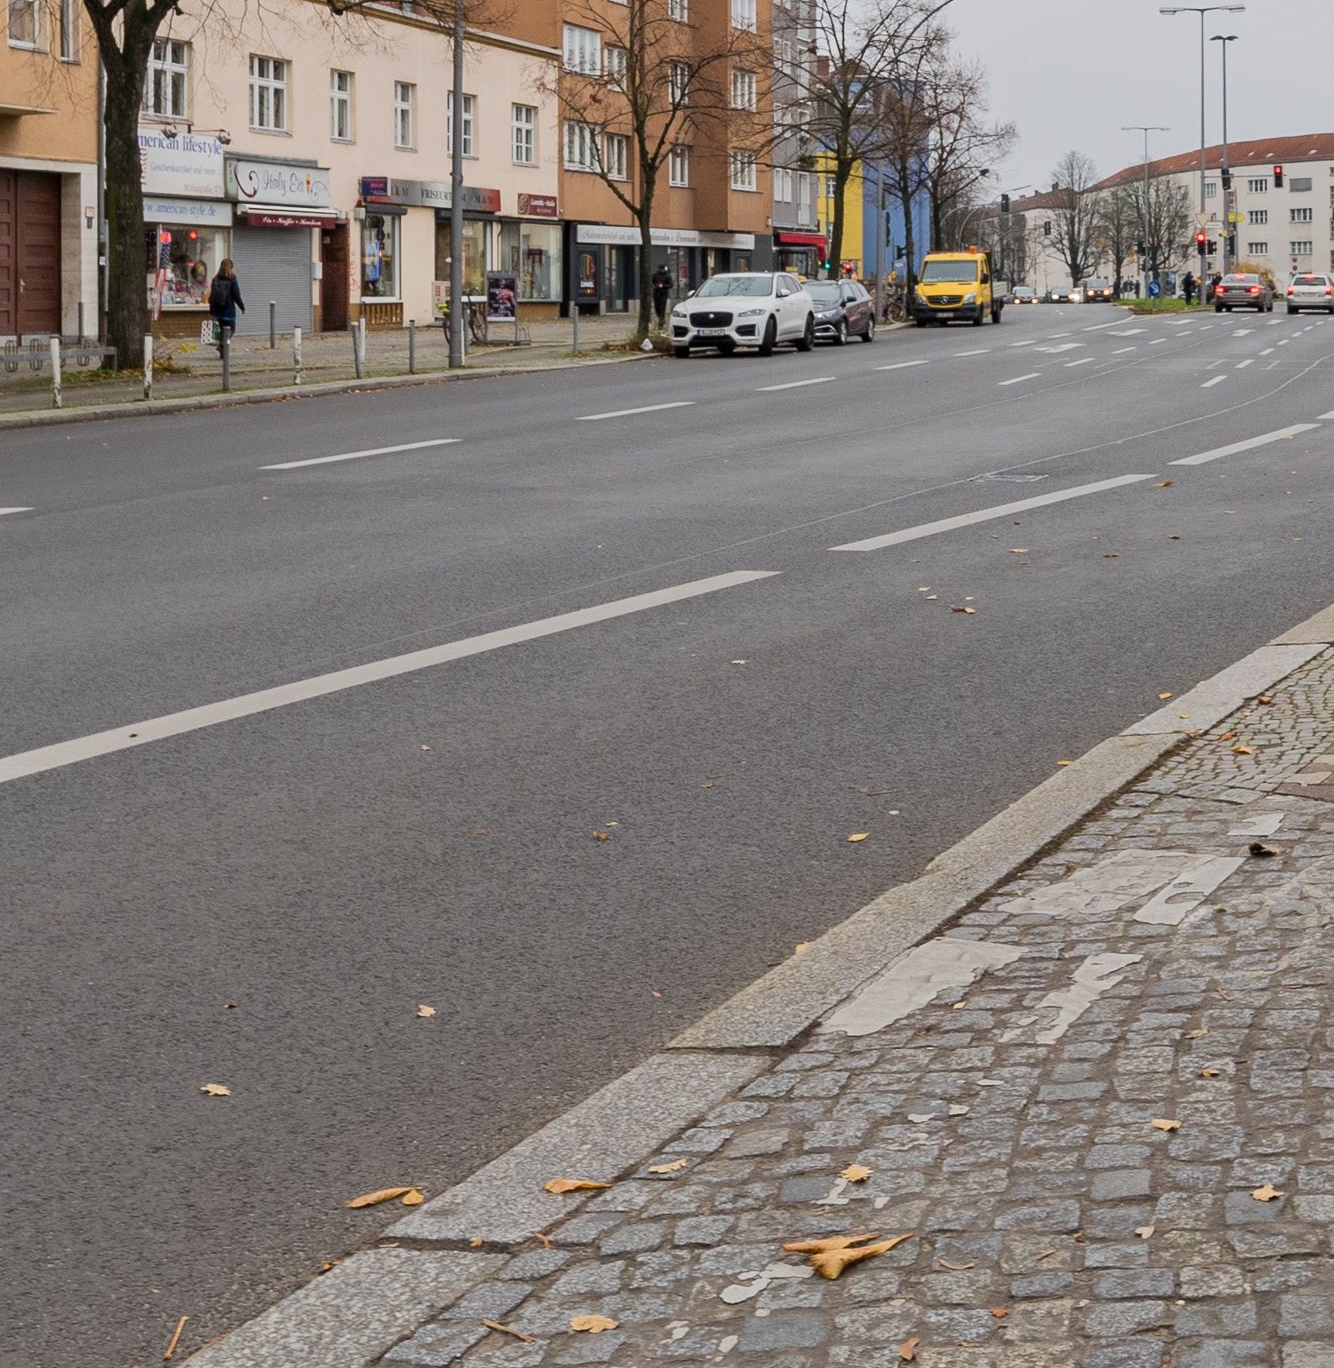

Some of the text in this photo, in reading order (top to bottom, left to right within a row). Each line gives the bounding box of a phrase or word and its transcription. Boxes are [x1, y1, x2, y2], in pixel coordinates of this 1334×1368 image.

[138, 133, 222, 158] merican lifestyle
[144, 203, 217, 217] w.american-style.de
